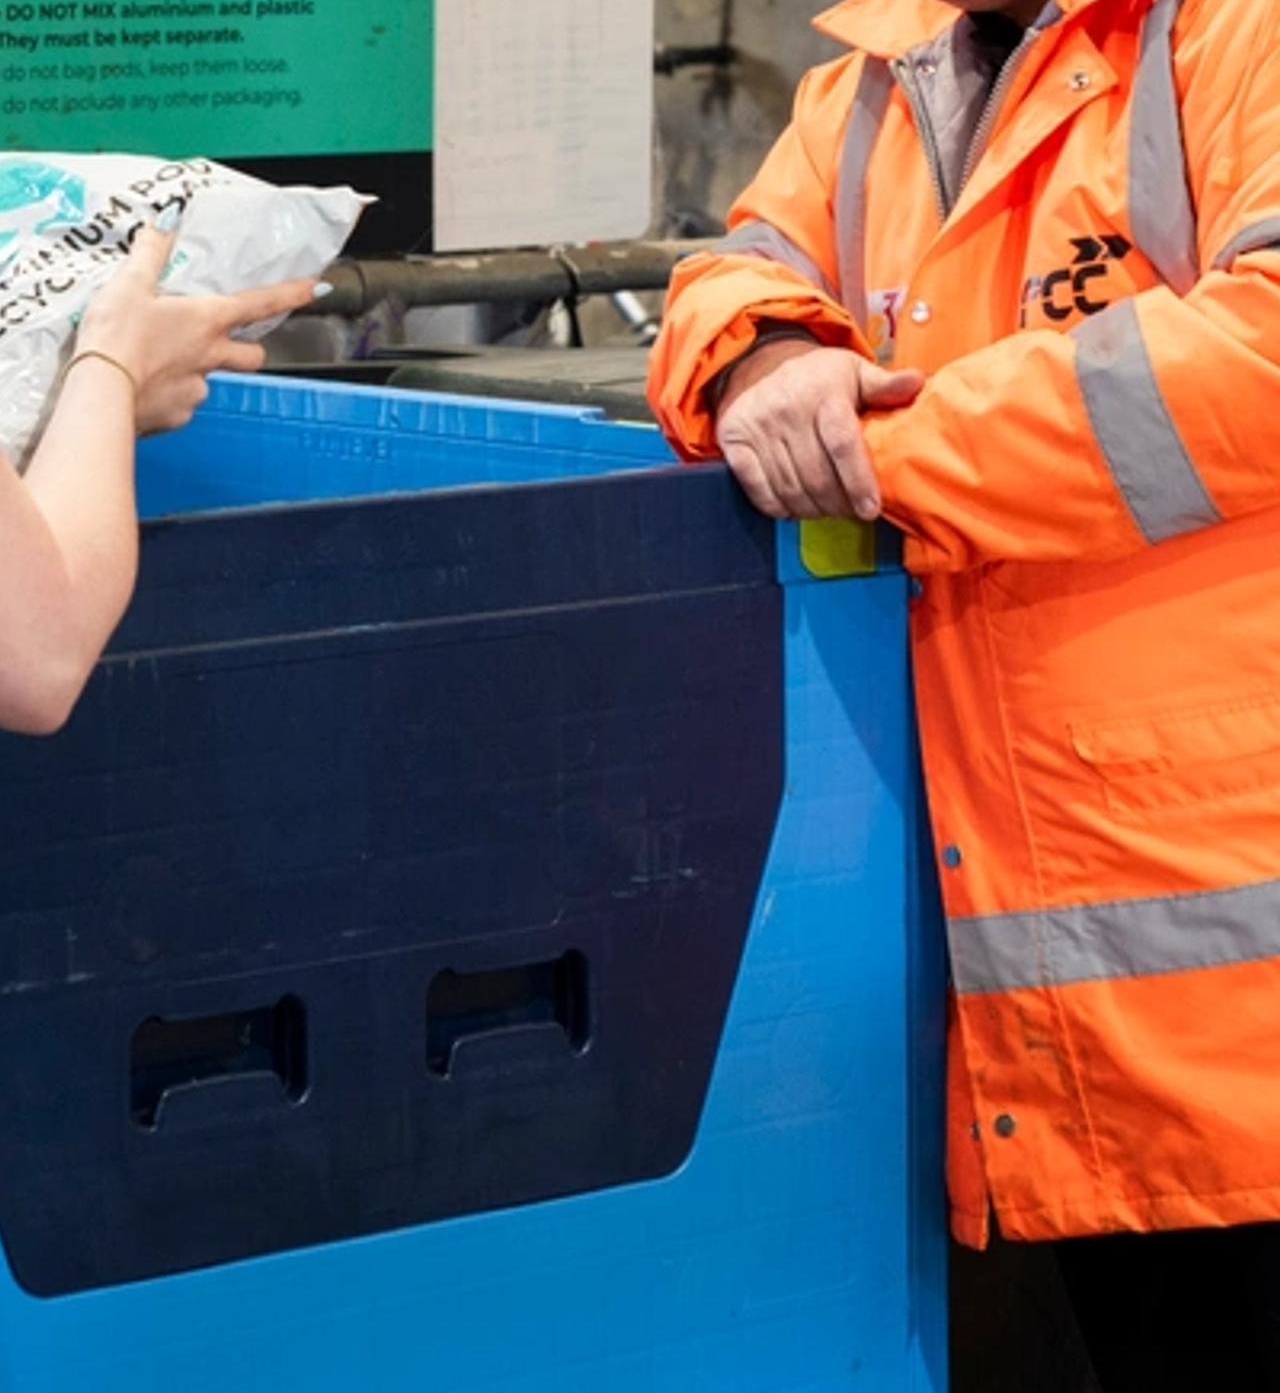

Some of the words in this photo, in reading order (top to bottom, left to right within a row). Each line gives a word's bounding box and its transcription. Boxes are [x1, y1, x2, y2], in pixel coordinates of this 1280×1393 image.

[5, 3, 35, 22] DO
[39, 2, 78, 20] NOT
[82, 1, 117, 19] MIX
[44, 31, 91, 47] must
[94, 28, 117, 47] be
[121, 27, 162, 49] kept
[166, 27, 245, 47] separate.
[3, 64, 26, 82] do
[29, 63, 59, 80] not
[63, 62, 97, 83] bag
[150, 59, 190, 80] keep
[192, 58, 239, 76] them
[3, 97, 26, 115] do
[29, 96, 59, 113] not
[62, 93, 126, 114] include
[130, 95, 161, 113] any
[163, 91, 209, 109] other
